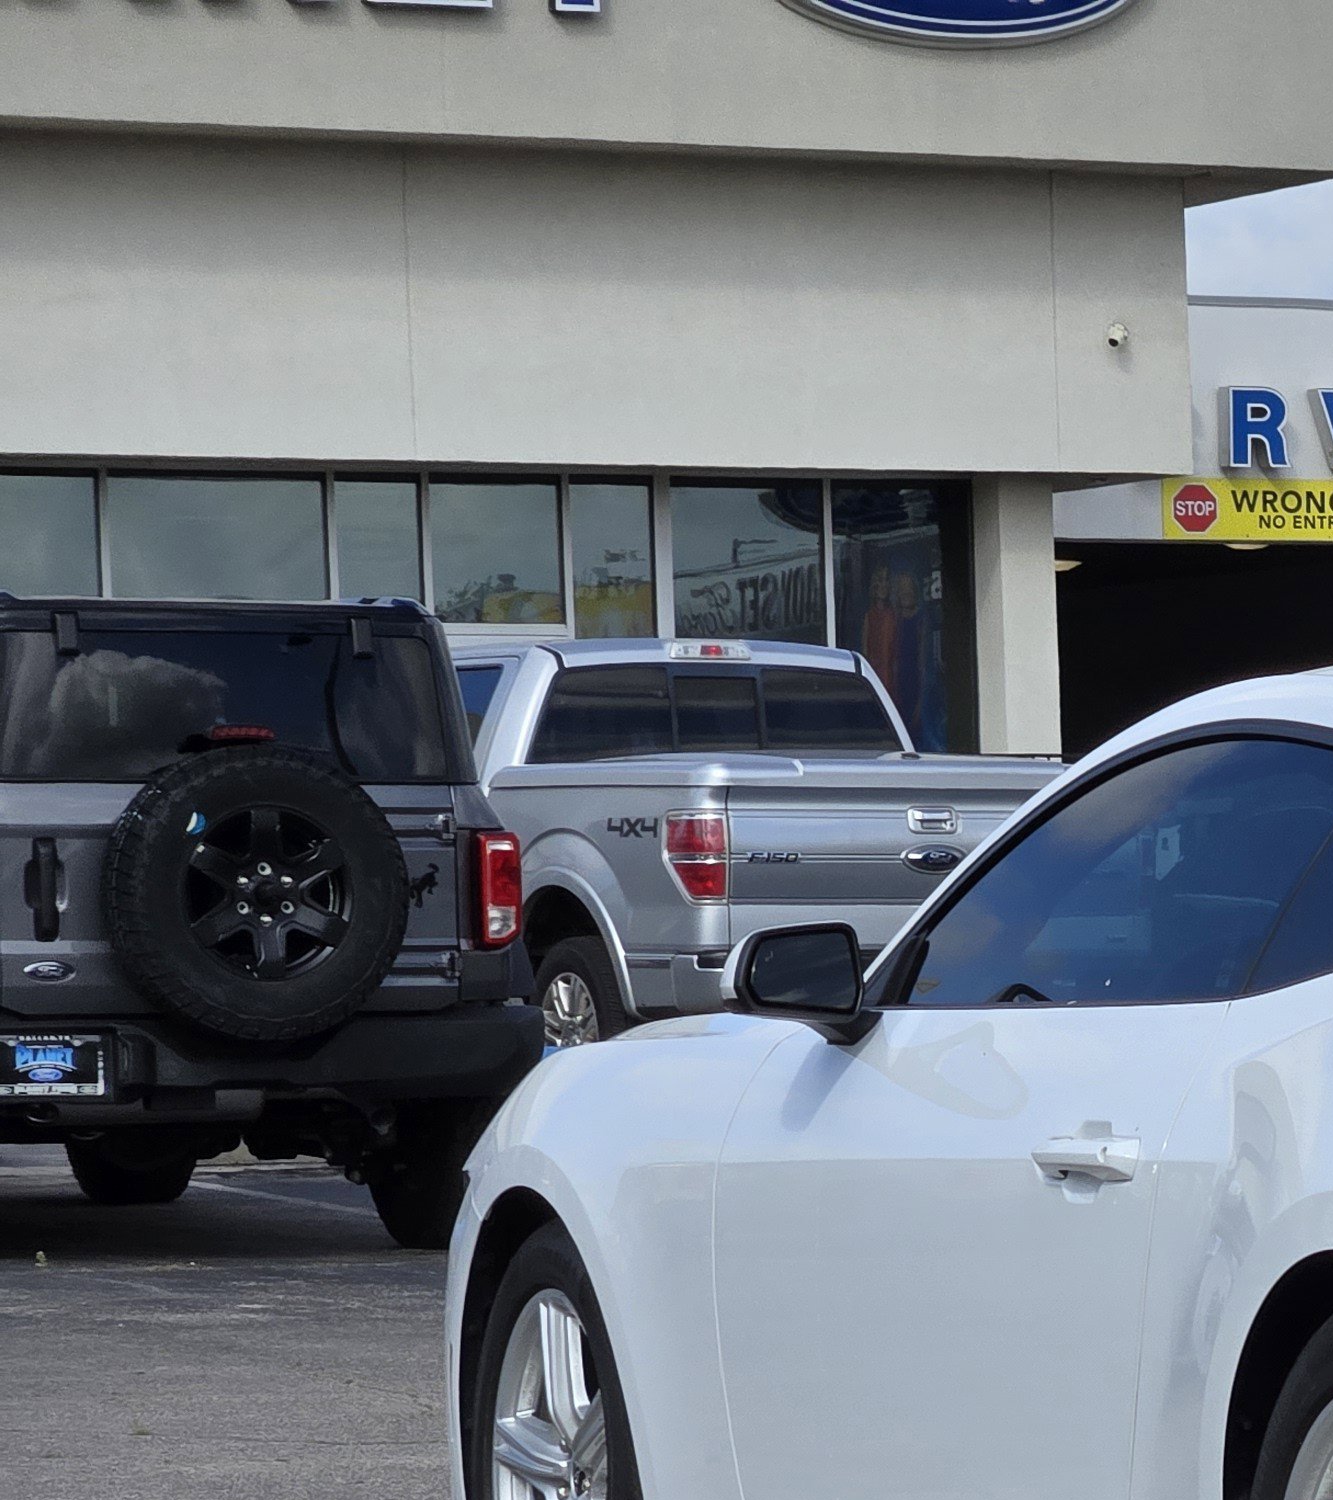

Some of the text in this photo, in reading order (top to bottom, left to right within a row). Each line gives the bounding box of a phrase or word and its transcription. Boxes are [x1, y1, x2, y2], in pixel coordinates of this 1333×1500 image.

[1175, 500, 1215, 516] STOP
[1258, 515, 1286, 529] NO
[607, 817, 659, 838] 4X4
